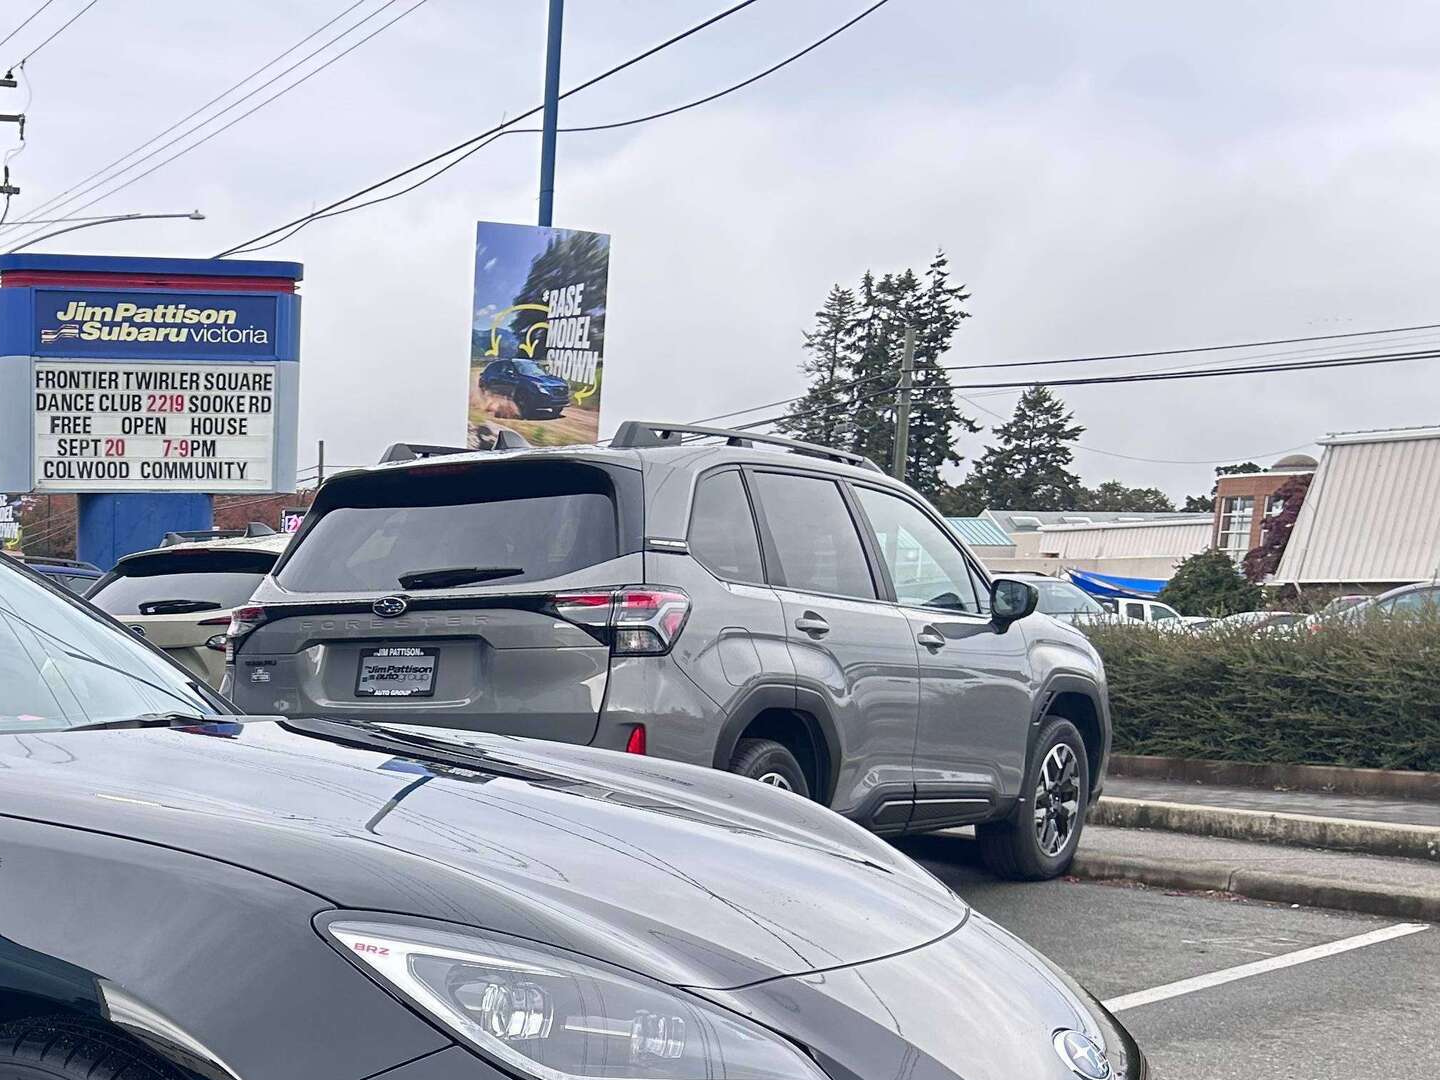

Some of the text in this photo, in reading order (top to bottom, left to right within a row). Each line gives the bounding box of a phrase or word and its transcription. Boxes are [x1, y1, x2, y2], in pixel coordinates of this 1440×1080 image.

[545, 316, 591, 349] MODEL
[545, 349, 599, 385] SHOWN
[36, 370, 272, 392] FRONTIER TWIRLER SQUARE
[36, 393, 271, 414] DANCE CLUB 2219 SOOKE RD
[50, 416, 248, 435] FREE OPEN HOUSE
[57, 438, 216, 457] SEPT 20 7-9PM
[44, 461, 247, 480] COLWOOD COMMUNITY
[299, 615, 489, 631] FORESTER
[377, 648, 420, 656] JIM PATTISON
[354, 942, 390, 956] BRZ
